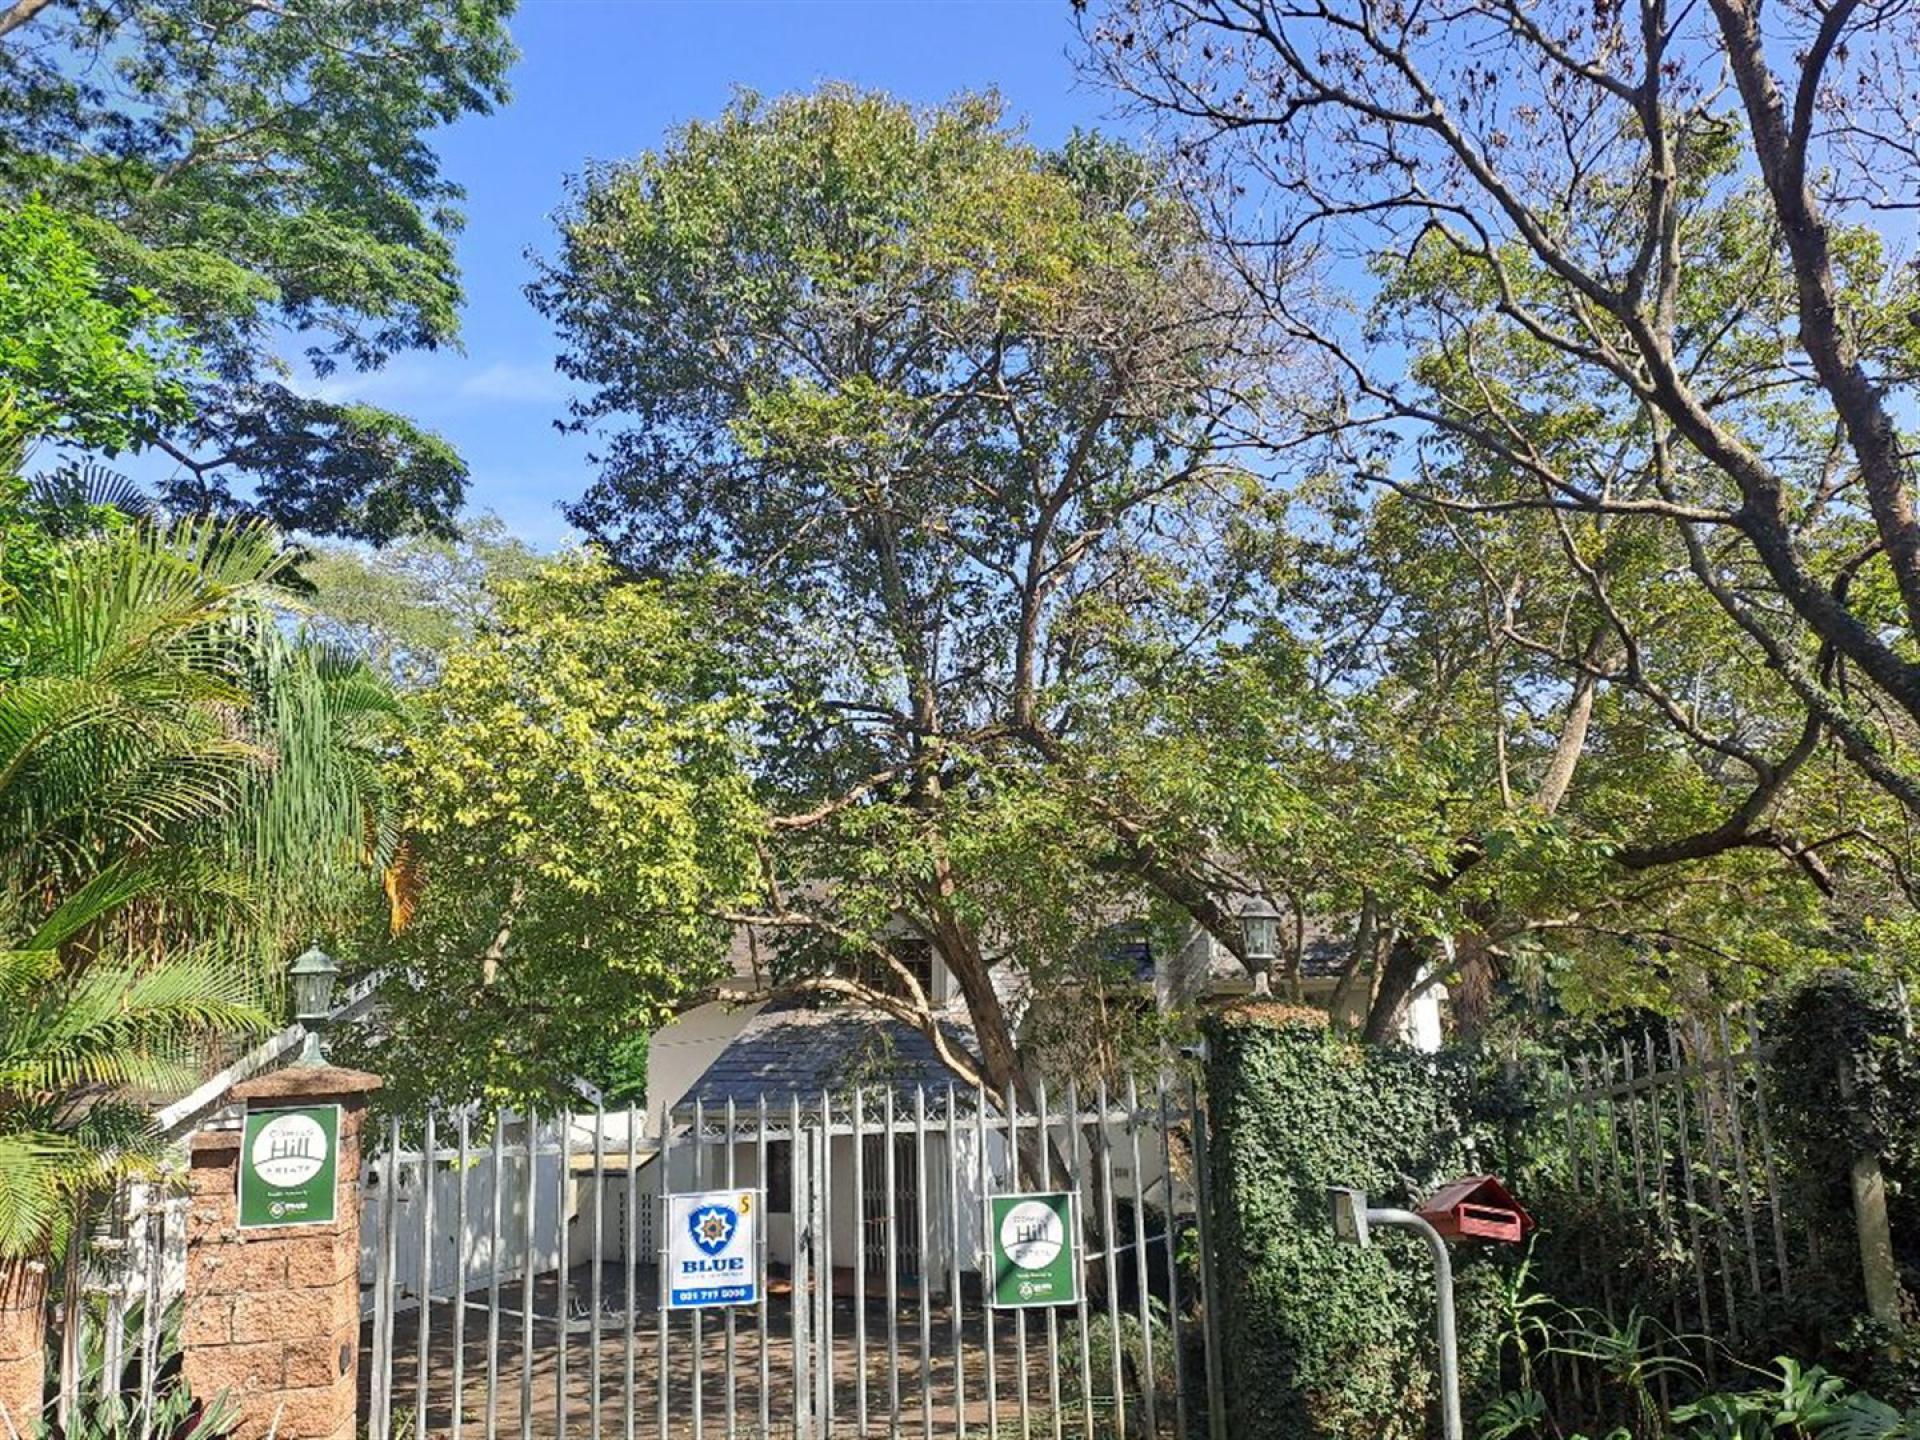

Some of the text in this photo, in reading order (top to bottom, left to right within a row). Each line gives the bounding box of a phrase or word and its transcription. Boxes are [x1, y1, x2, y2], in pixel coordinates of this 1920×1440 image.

[271, 1137, 310, 1158] Hill
[1017, 1223, 1049, 1243] Hill
[682, 1257, 744, 1273] BLUE
